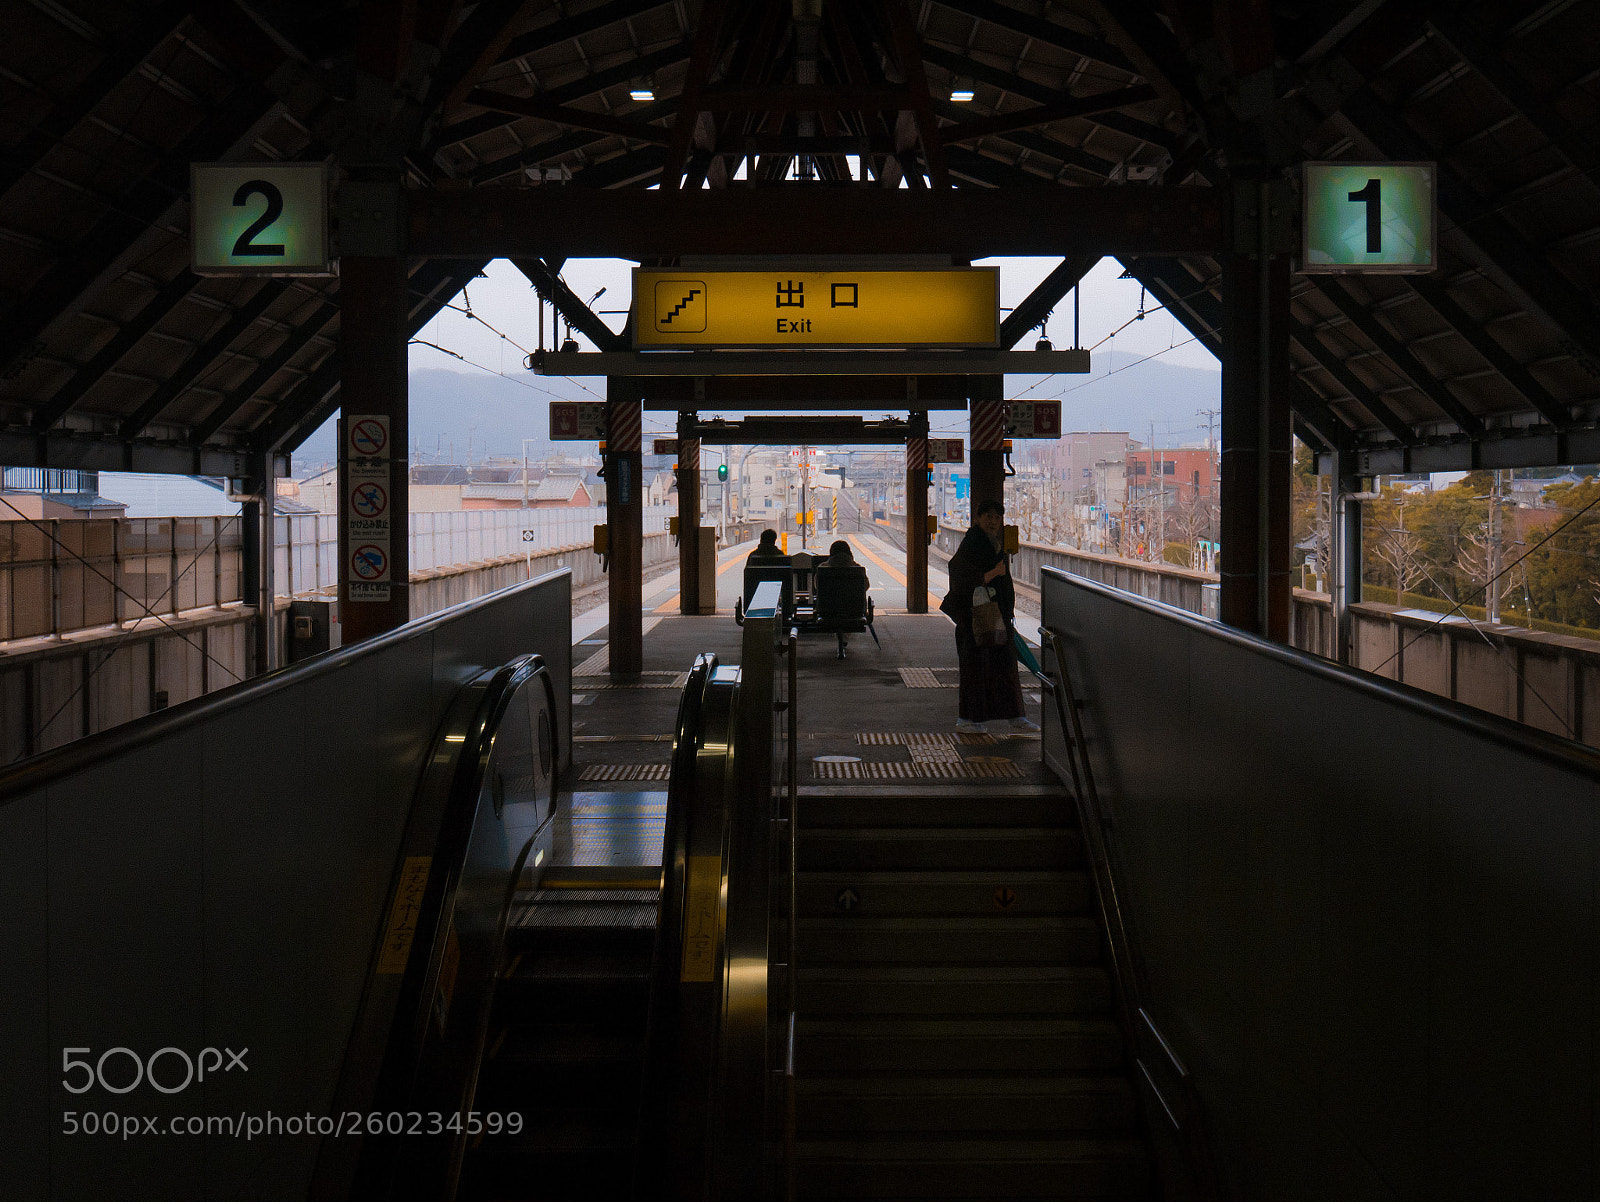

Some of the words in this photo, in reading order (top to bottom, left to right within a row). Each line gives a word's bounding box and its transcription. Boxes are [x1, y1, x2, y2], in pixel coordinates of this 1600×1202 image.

[232, 180, 284, 256] 2
[1348, 179, 1381, 253] 1
[776, 280, 859, 309] 出口
[777, 318, 812, 333] Exit
[1036, 407, 1056, 415] SOS
